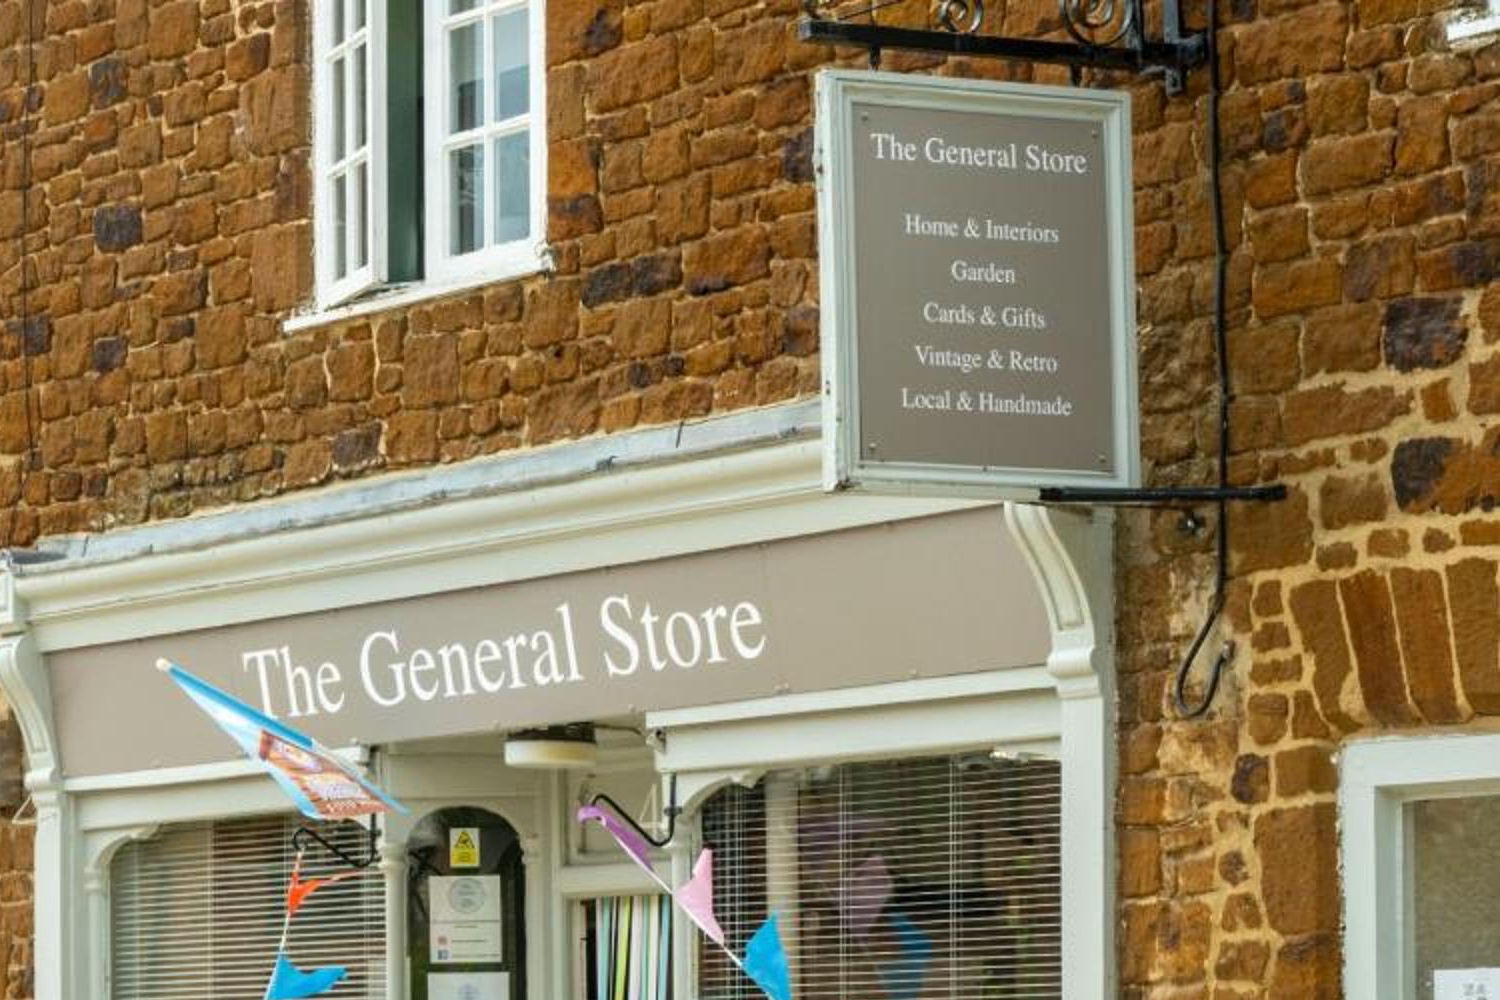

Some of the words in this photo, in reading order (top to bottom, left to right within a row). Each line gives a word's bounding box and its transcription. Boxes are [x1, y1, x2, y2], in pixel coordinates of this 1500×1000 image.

[870, 133, 917, 161] The
[924, 137, 1017, 169] General
[1025, 144, 1088, 174] Store
[905, 213, 959, 237] Home
[963, 217, 980, 238] &
[985, 219, 1060, 243] Interiors
[951, 259, 1016, 284] Garden
[923, 301, 976, 324] Cards
[980, 305, 997, 326] &
[1001, 307, 1046, 329] Gifts
[915, 345, 982, 373] Vintage
[987, 349, 1004, 369] &
[1010, 350, 1058, 372] Retro
[901, 387, 951, 410] Local
[956, 390, 973, 411] &
[979, 392, 1073, 416] Handmade
[242, 645, 345, 719] The
[360, 603, 583, 706] General
[600, 595, 766, 677] Store
